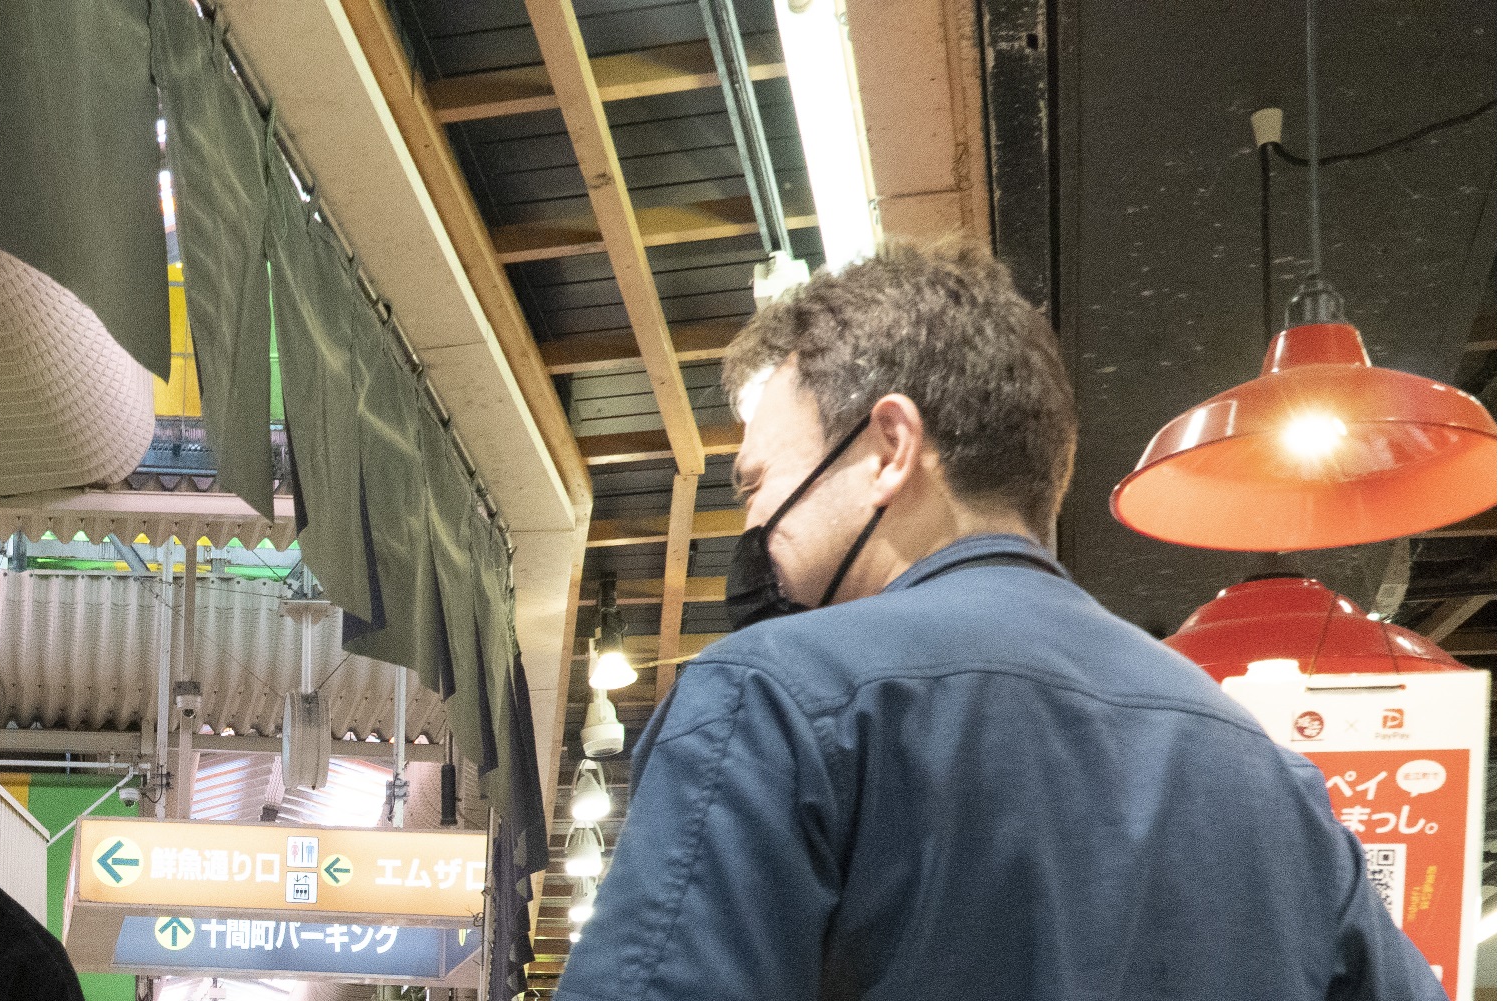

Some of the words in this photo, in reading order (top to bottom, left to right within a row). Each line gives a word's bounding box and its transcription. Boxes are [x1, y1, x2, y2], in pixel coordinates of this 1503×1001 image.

[150, 846, 281, 884] 鮮魚通り口
[201, 918, 400, 955] 十間町パーキング
